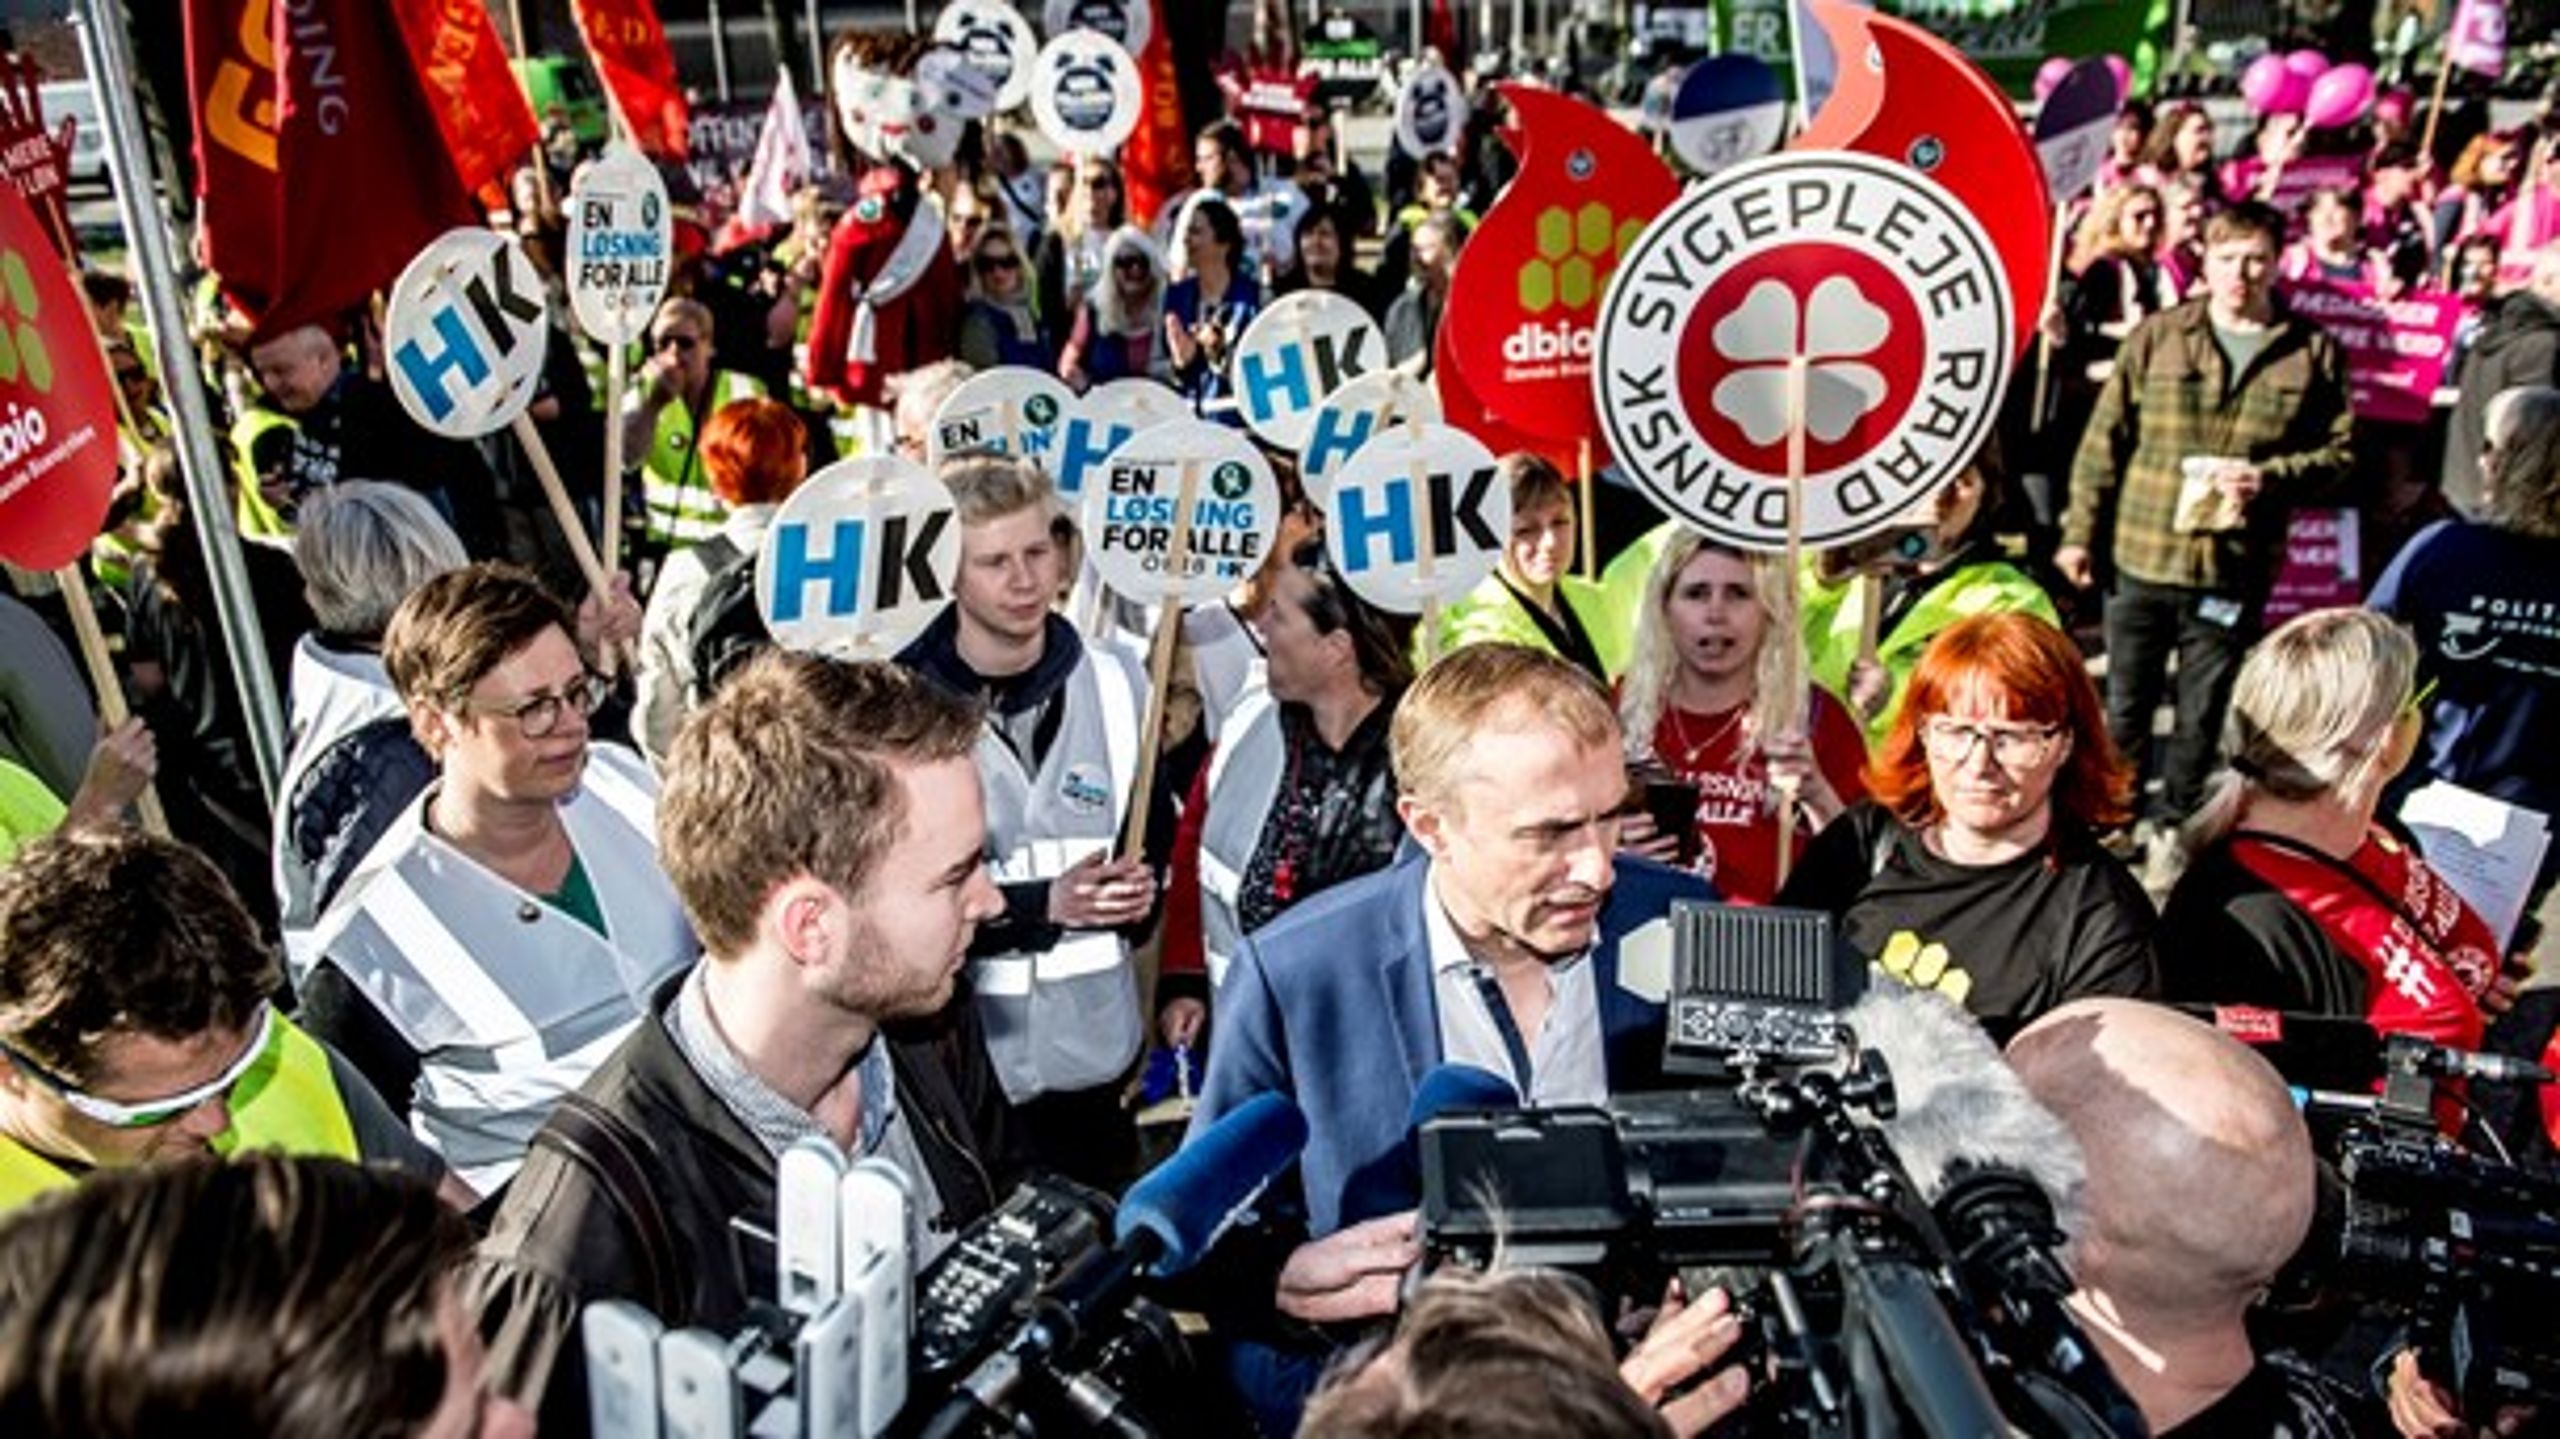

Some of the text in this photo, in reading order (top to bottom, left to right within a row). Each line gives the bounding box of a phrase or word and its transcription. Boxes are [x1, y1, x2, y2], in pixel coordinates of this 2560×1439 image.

[583, 200, 614, 229] EN
[1626, 179, 1983, 334] SYGEPLEJE
[394, 241, 543, 424] HK
[1241, 323, 1370, 422] HK
[940, 418, 979, 450] EN
[1110, 467, 1156, 495] EN
[772, 507, 954, 623] HK
[1103, 524, 1171, 552] FOR
[1338, 465, 1503, 572] HK
